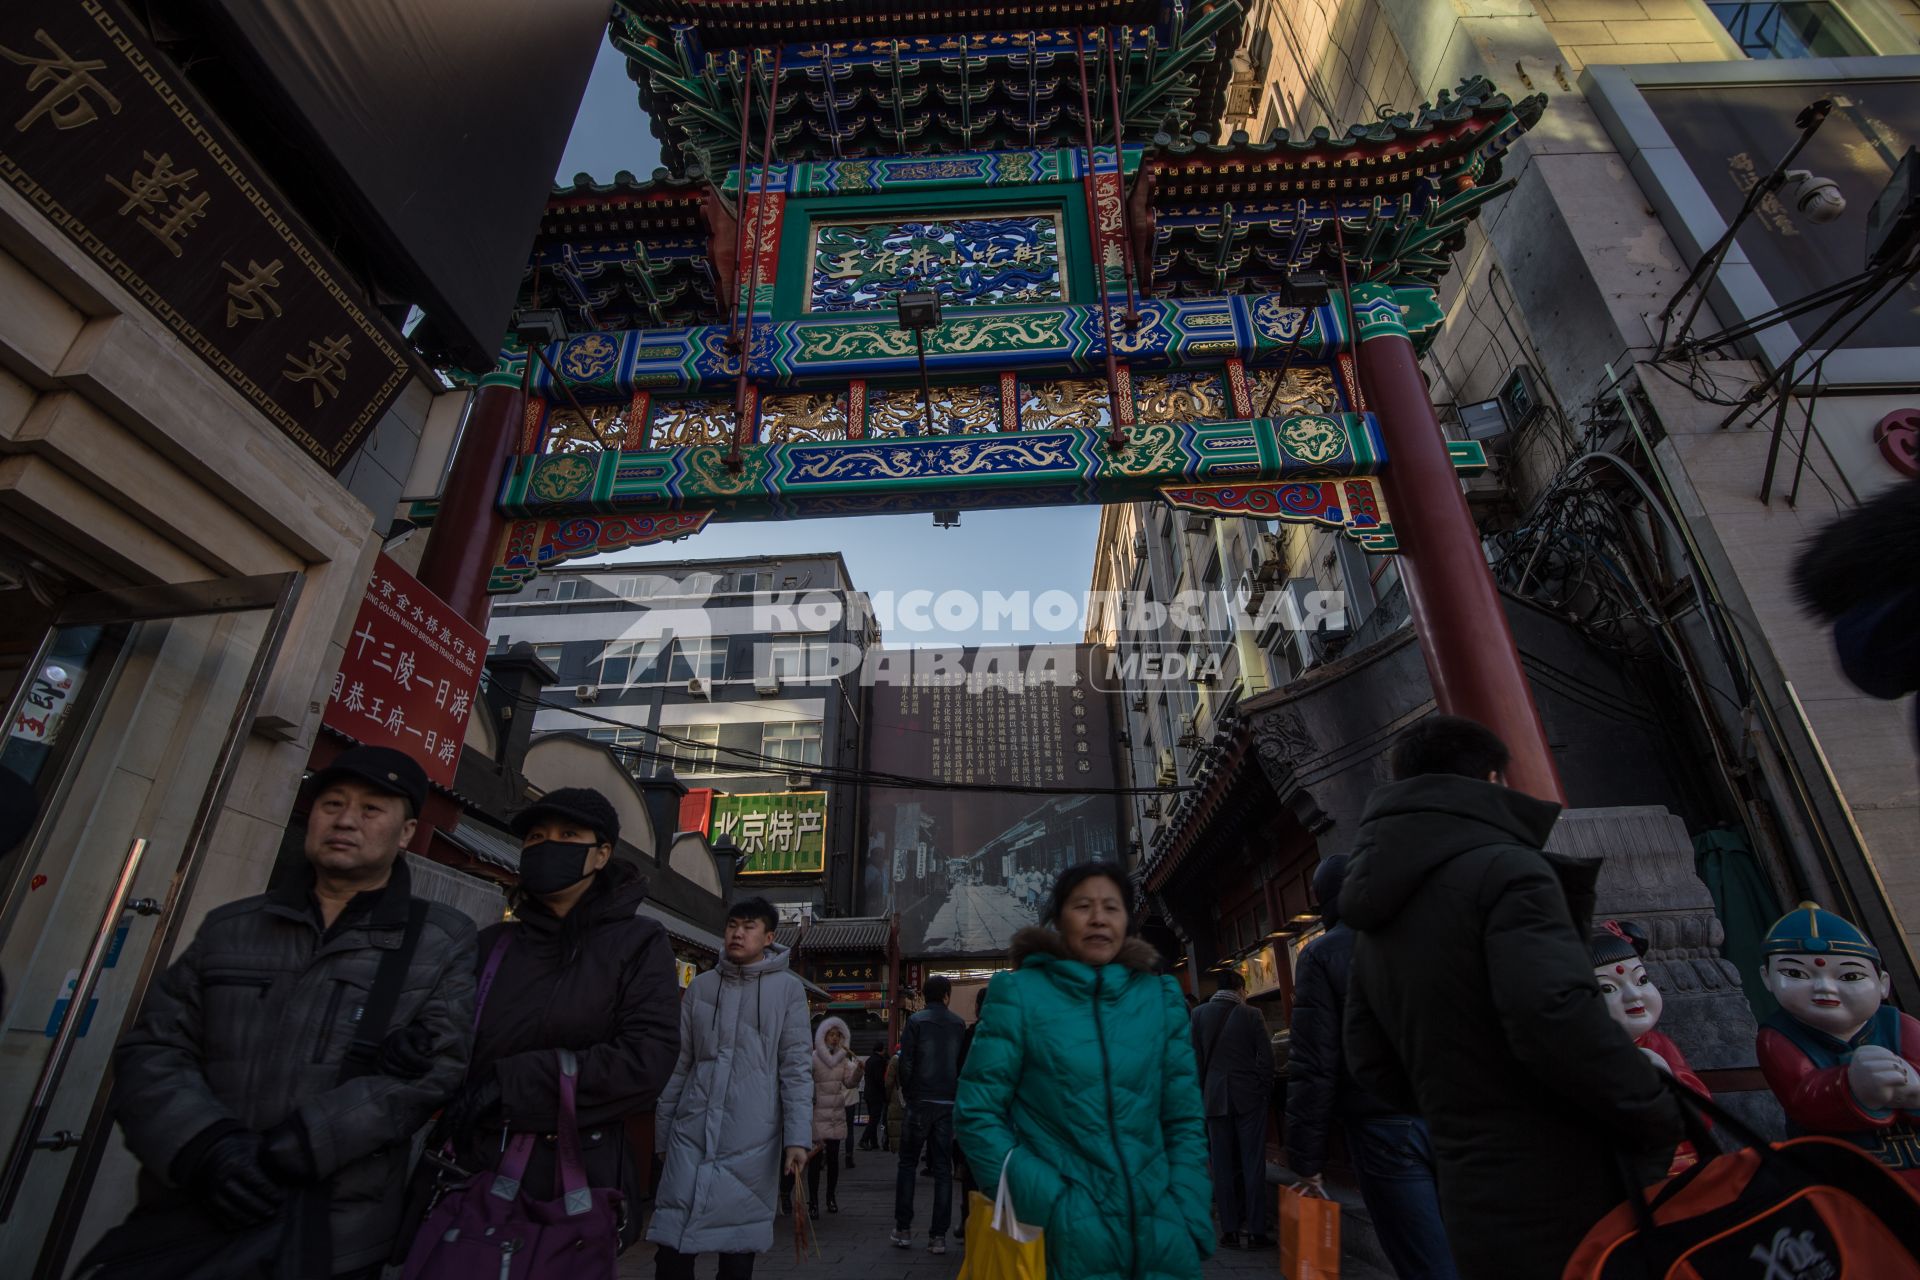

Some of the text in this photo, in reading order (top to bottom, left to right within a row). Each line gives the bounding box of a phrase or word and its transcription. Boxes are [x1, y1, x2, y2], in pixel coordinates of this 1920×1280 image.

[0, 28, 353, 408] 布鞋专卖
[829, 243, 1046, 278] 王府井小吃街
[354, 621, 470, 723] 十三陵一日游
[379, 601, 401, 622] GOLDEN
[400, 617, 418, 636] WATER
[418, 631, 439, 651] BRIDGES
[439, 646, 456, 664] TRAVEL
[456, 659, 473, 677] SERVICE
[713, 807, 821, 854] 北京特产
